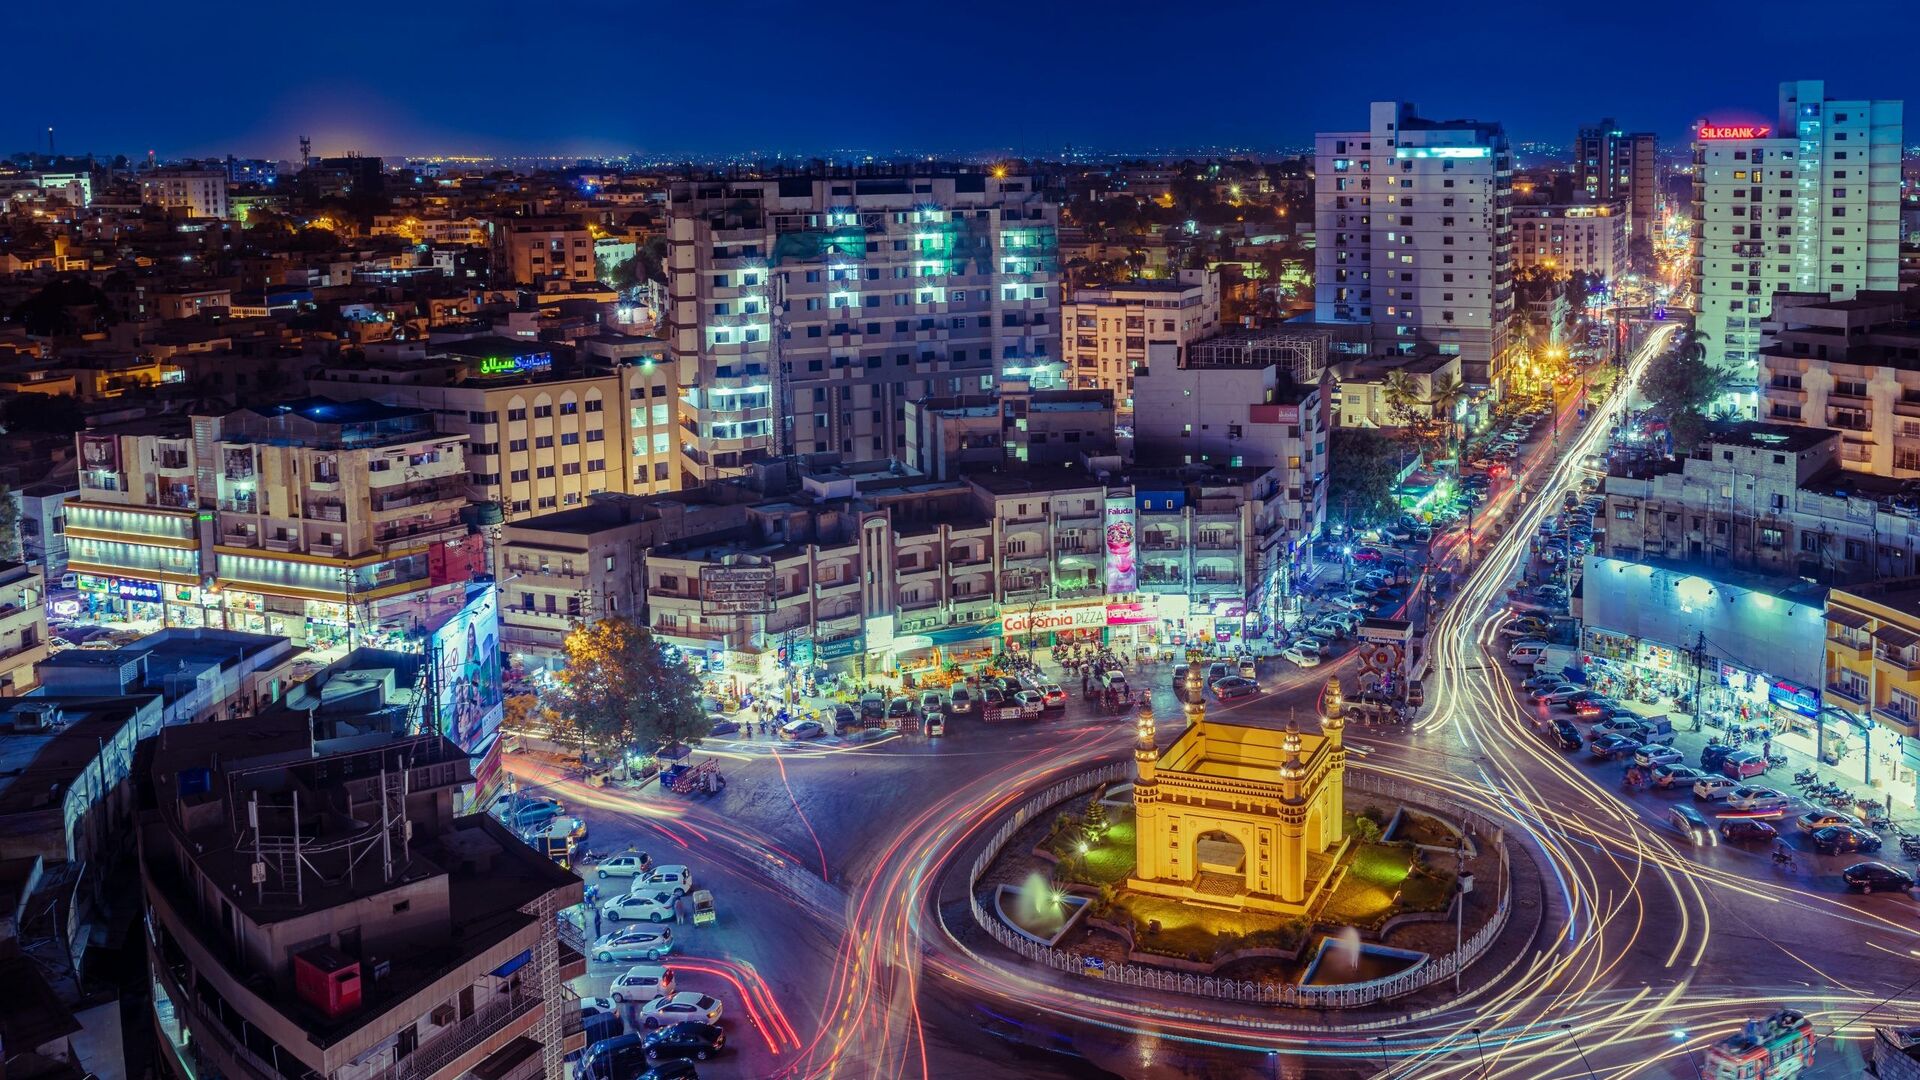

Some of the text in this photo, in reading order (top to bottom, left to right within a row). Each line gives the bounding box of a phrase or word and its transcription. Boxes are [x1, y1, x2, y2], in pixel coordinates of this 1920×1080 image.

[1701, 127, 1755, 138] SILKBANK
[1108, 507, 1133, 515] Faluda
[1004, 613, 1073, 632] California
[1076, 611, 1104, 625] PIZZA
